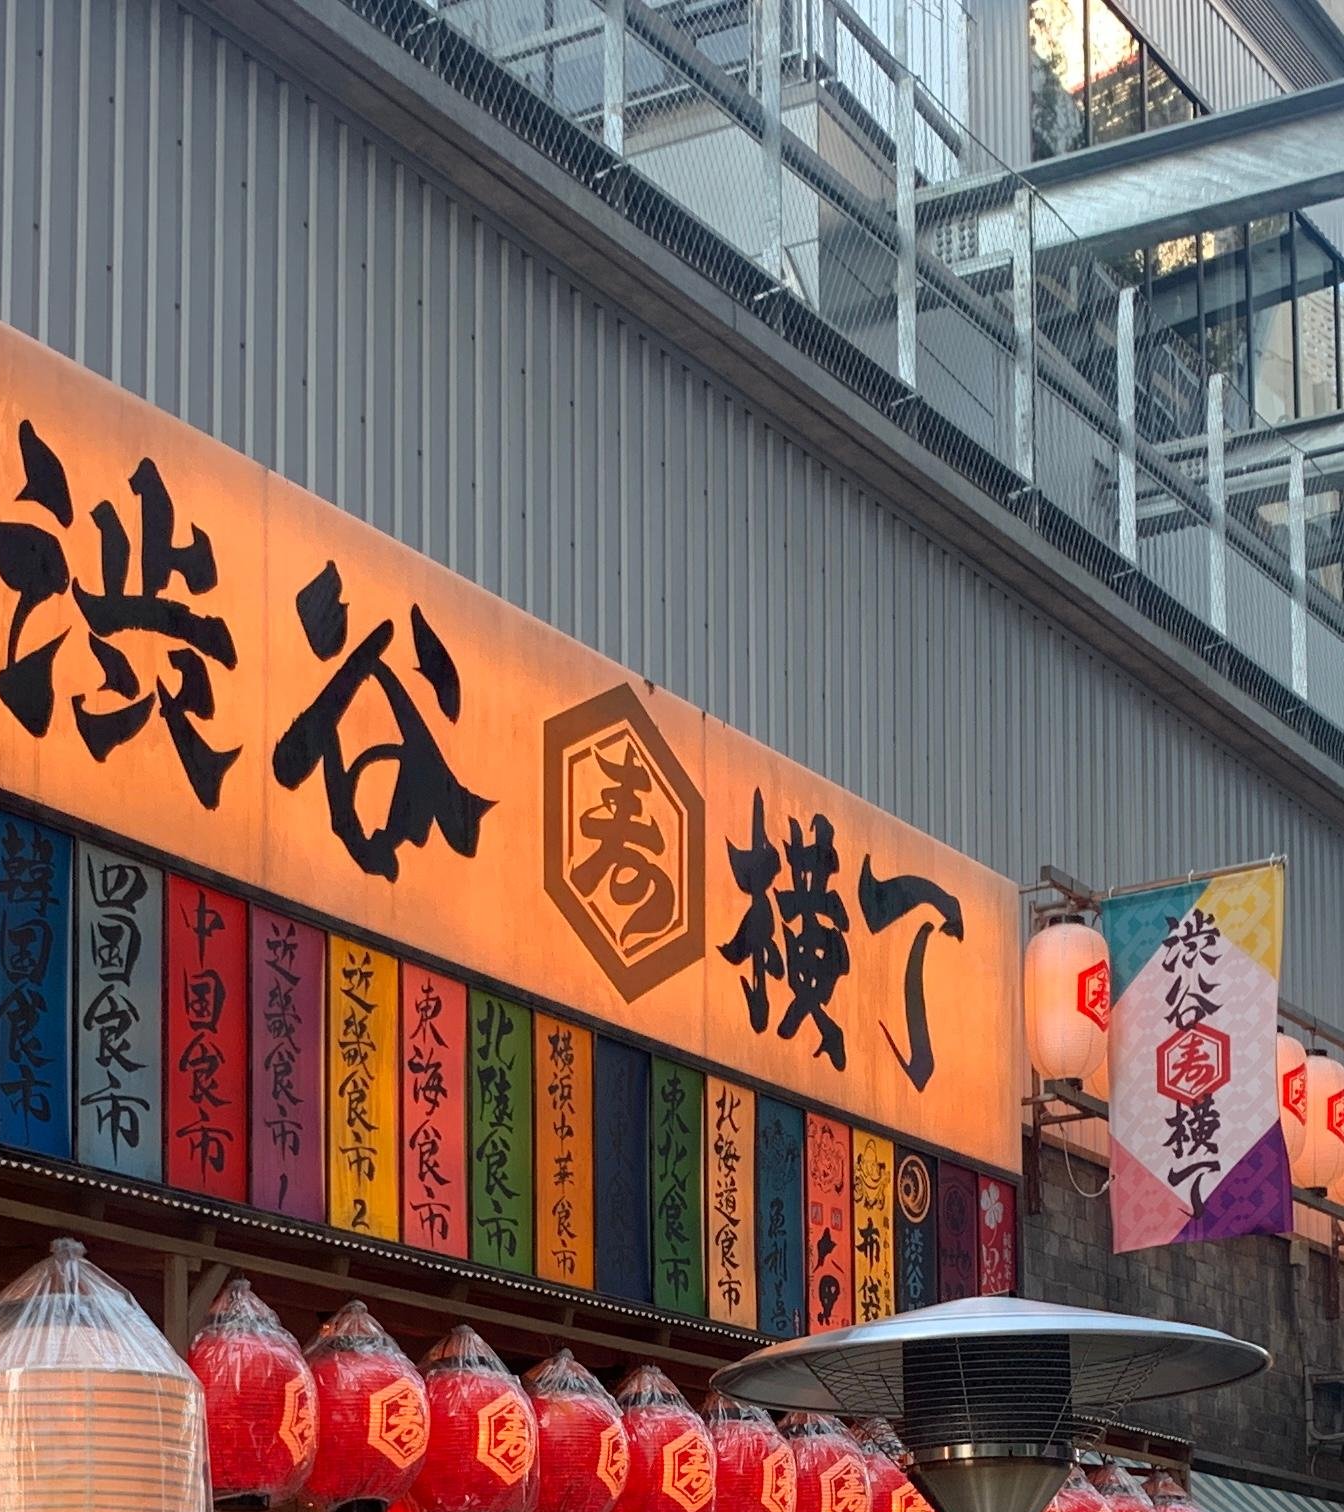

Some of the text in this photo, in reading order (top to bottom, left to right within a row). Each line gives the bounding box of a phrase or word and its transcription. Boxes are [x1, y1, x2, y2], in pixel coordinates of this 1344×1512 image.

[81, 853, 148, 1165] 四国食市
[408, 978, 451, 1248] 東海食市
[476, 1001, 520, 1265] 北陸食市
[548, 1025, 577, 1280] 横浜中華食市
[658, 1069, 691, 1310] 東北食市
[714, 1086, 742, 1317] 北海道食市
